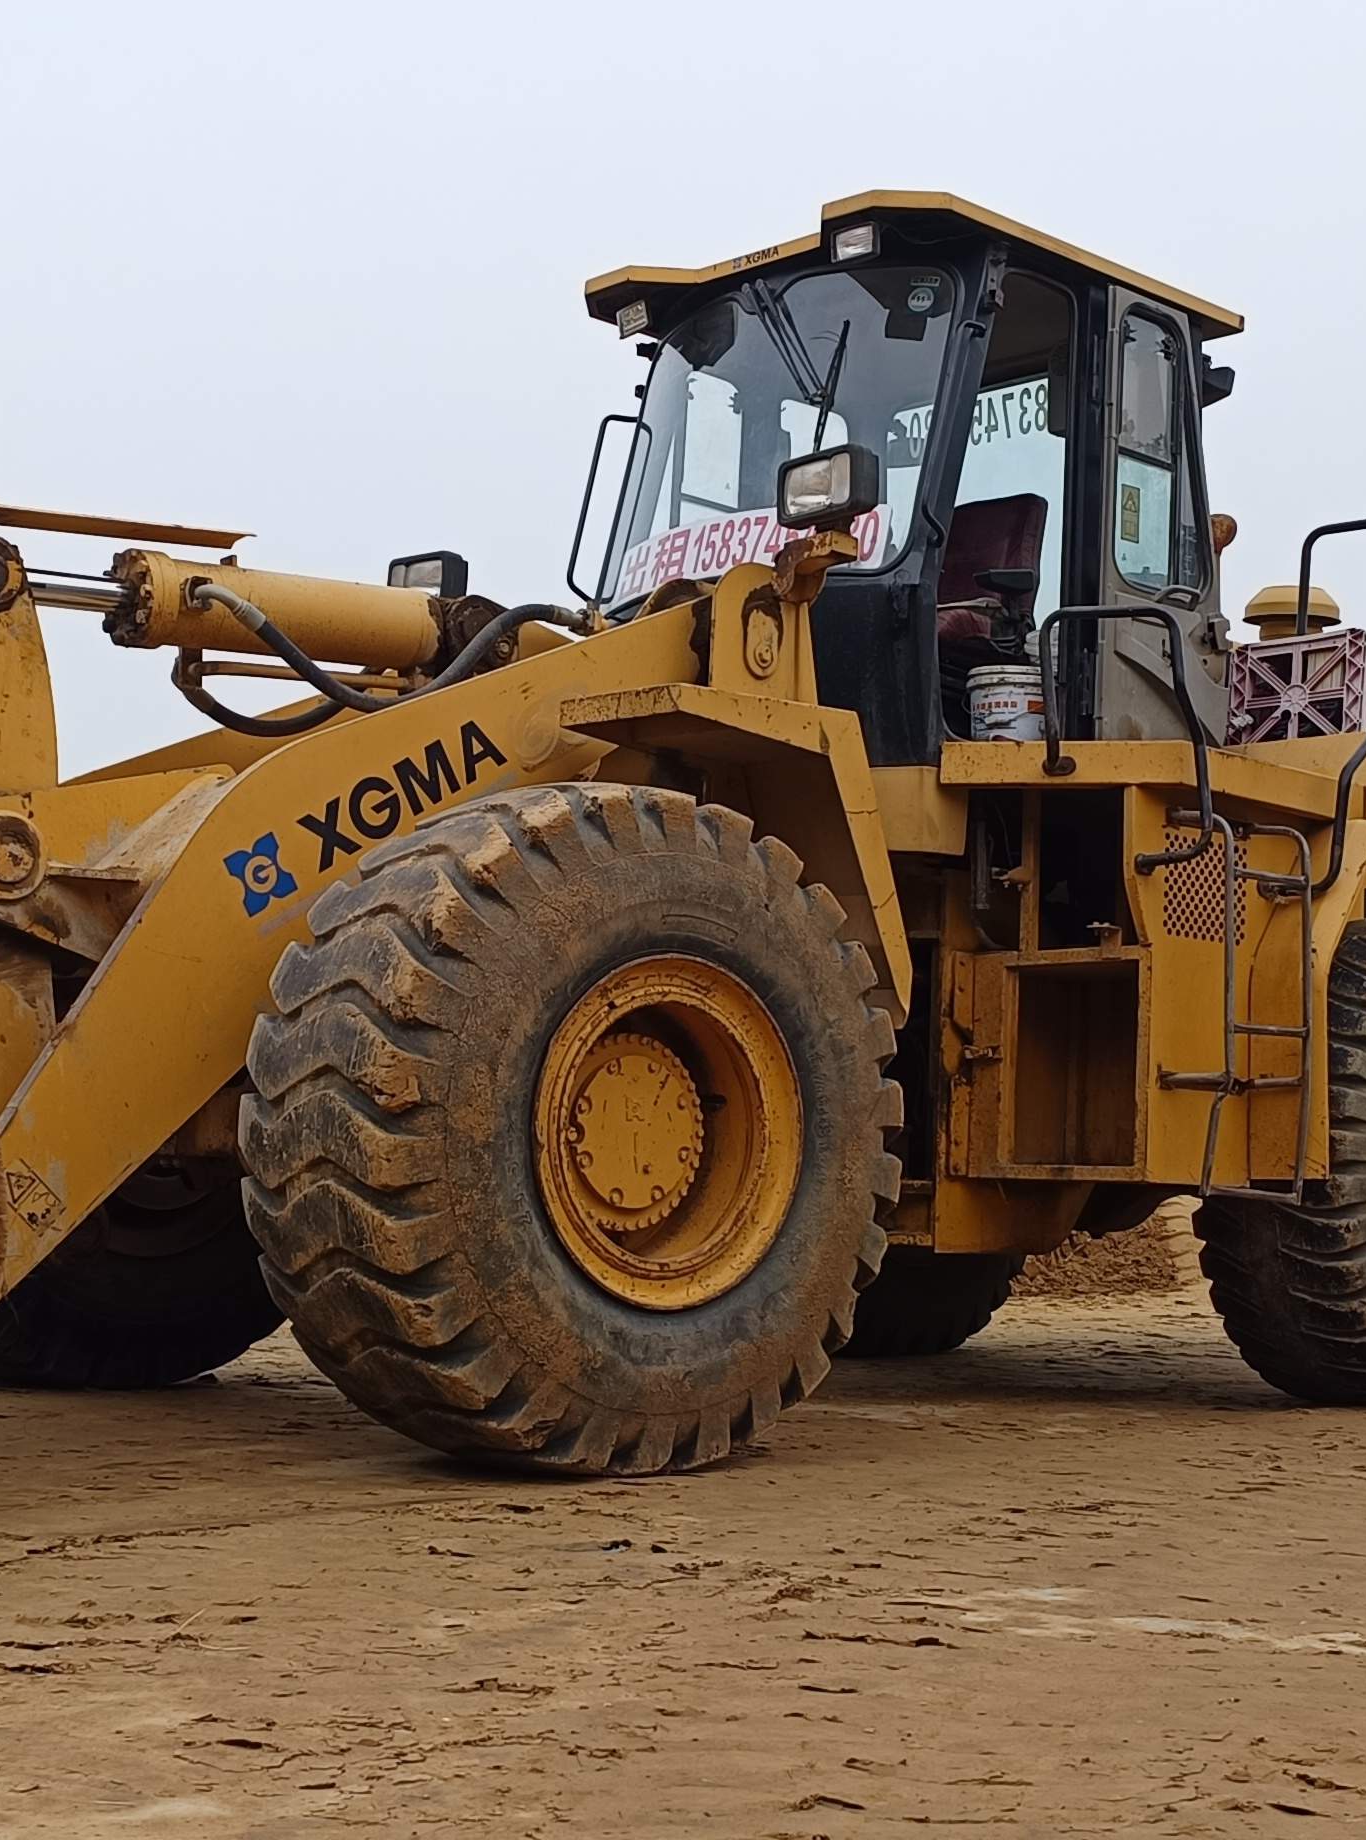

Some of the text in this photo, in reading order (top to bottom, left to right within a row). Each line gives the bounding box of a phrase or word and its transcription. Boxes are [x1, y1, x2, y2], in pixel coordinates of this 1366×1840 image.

[745, 246, 779, 266] XGMA
[619, 528, 690, 601] 出租
[296, 720, 508, 873] XGMA
